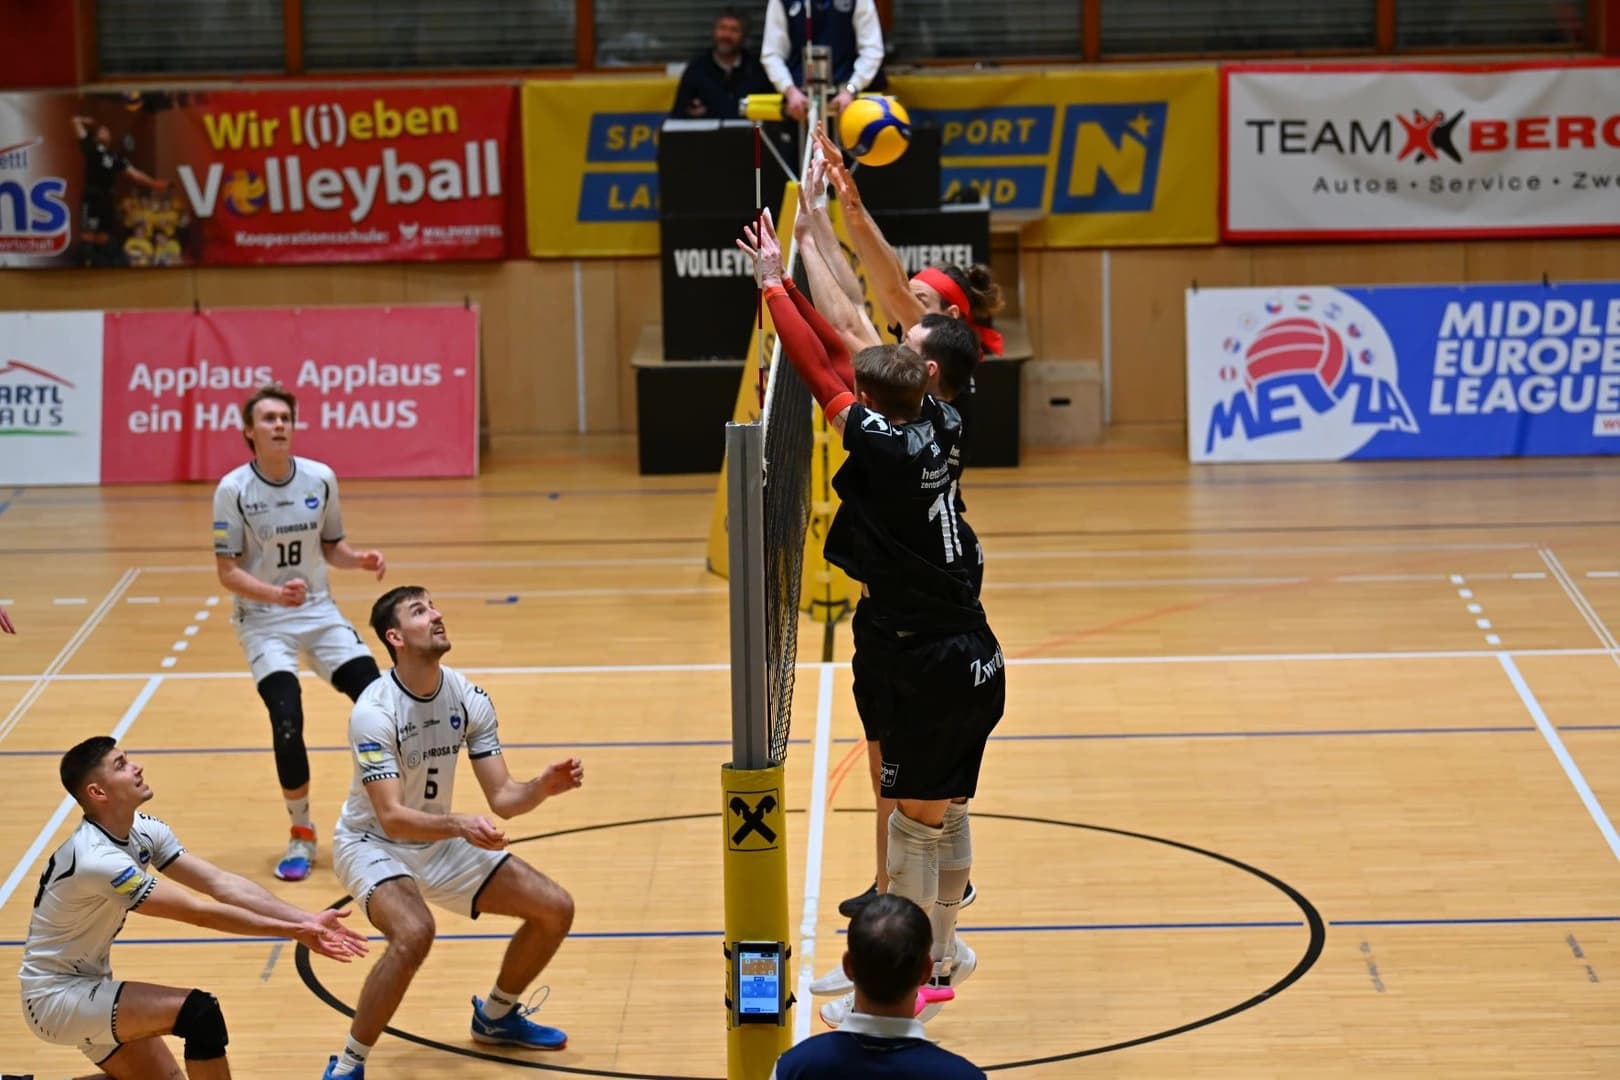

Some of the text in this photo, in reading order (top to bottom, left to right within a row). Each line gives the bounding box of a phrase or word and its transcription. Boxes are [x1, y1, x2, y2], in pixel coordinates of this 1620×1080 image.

[203, 99, 459, 151] Wir l(i)eben
[606, 124, 661, 151] SP
[1245, 118, 1392, 155] TEAM
[607, 183, 660, 210] LA
[1313, 175, 1399, 194] Autos
[1429, 173, 1541, 194] Service
[296, 357, 442, 394] Applaus
[1428, 374, 1620, 415] LEAGUE
[127, 403, 182, 433] ein
[321, 399, 418, 429] HAUS
[276, 540, 302, 568] 18
